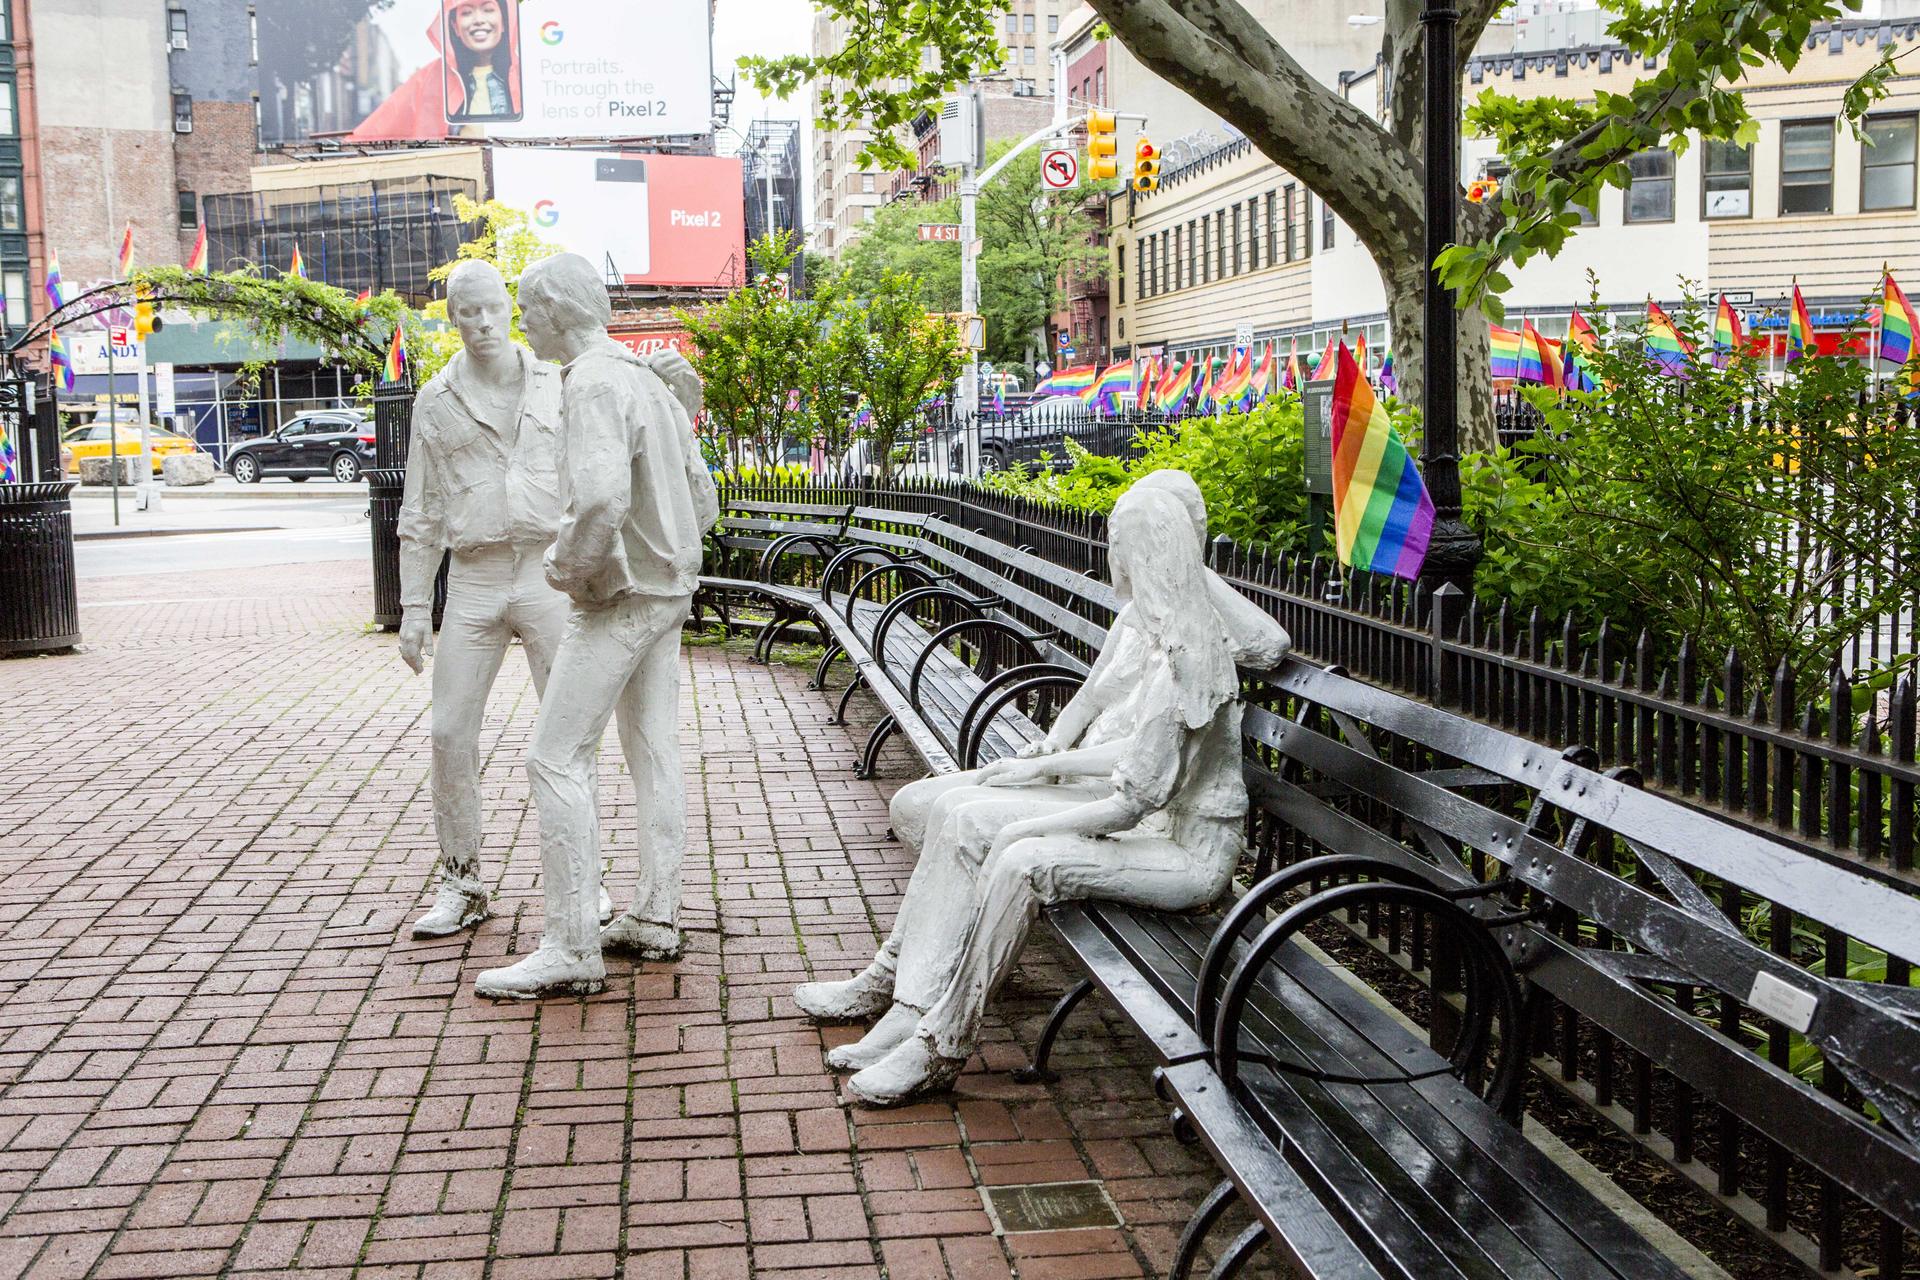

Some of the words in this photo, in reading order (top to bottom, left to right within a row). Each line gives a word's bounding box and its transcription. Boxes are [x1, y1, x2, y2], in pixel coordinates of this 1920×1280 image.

[540, 58, 624, 76] Portraits.
[543, 79, 618, 100] Through
[625, 78, 654, 95] the
[542, 102, 579, 119] lens
[584, 101, 602, 118] of
[609, 100, 652, 117] Pixel
[656, 101, 667, 116] 2
[670, 210, 708, 227] Pixel
[711, 211, 721, 227] 2
[921, 226, 931, 240] W
[934, 226, 942, 240] 4
[945, 227, 956, 240] ST
[1239, 335, 1251, 344] 20
